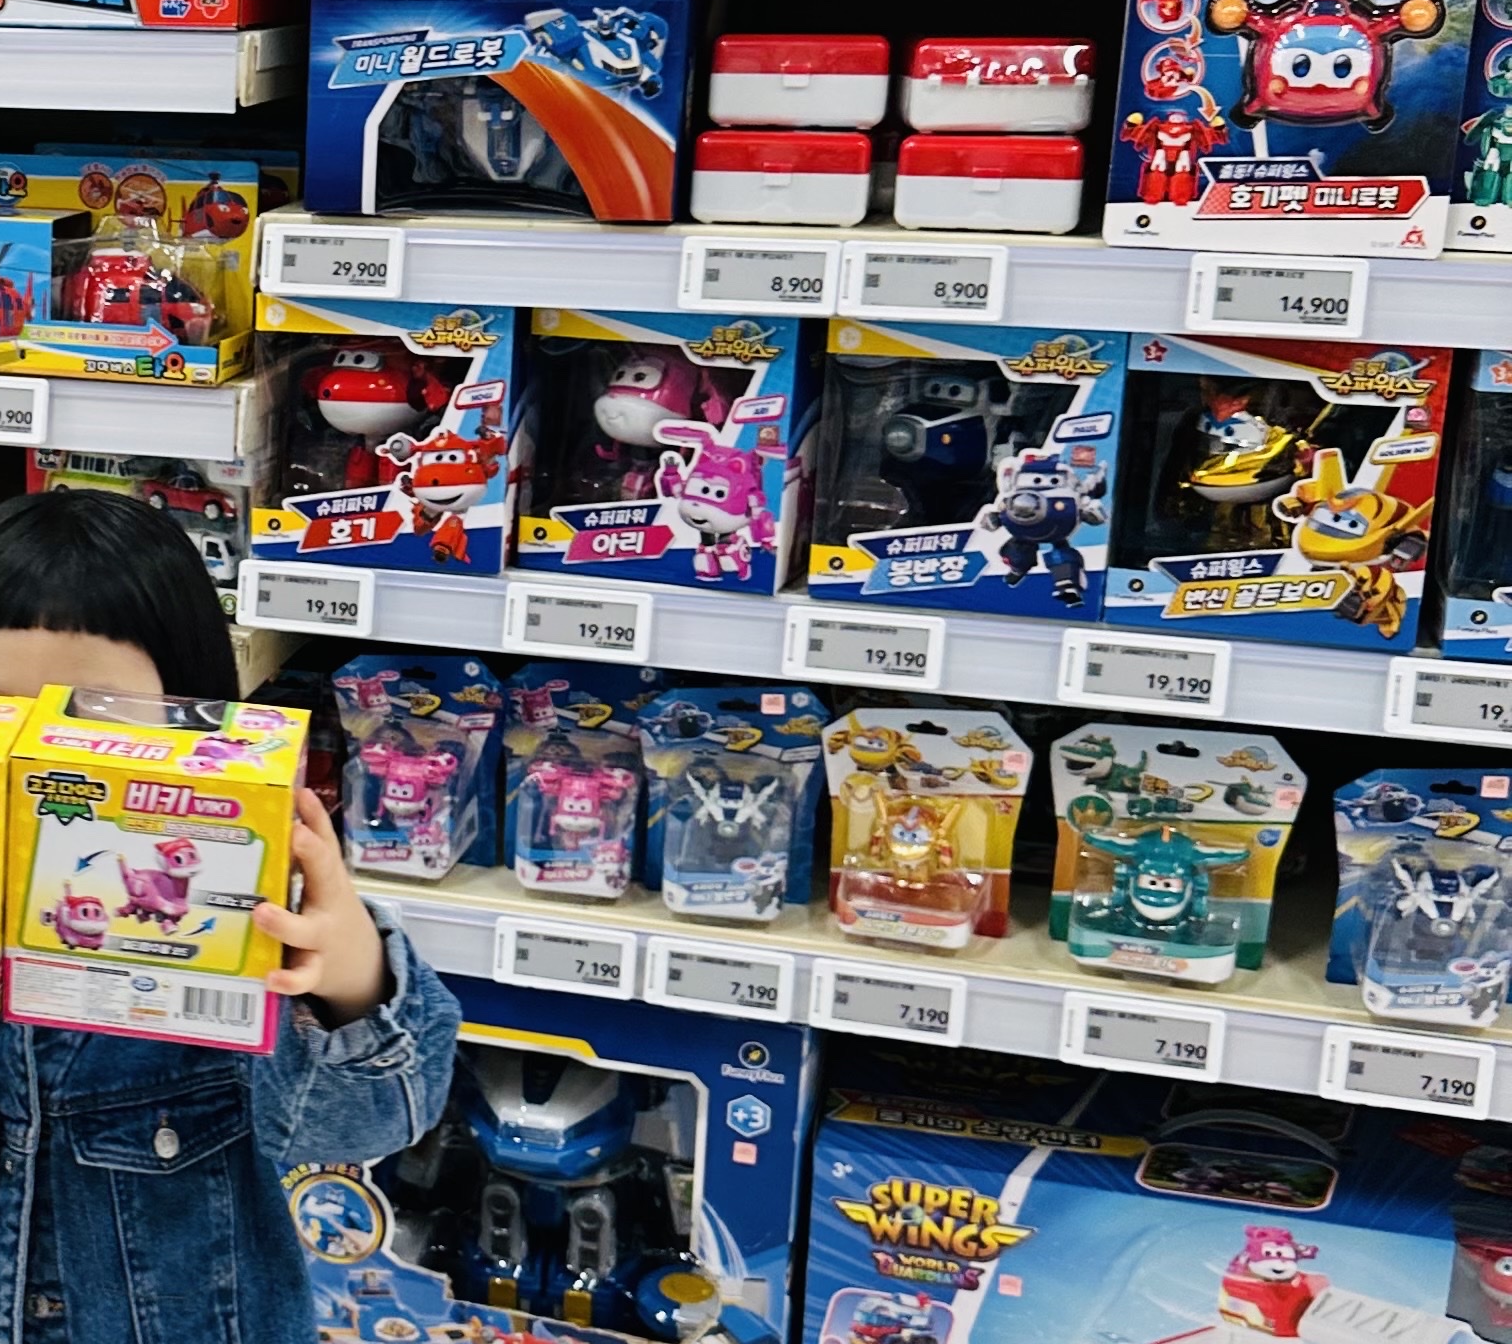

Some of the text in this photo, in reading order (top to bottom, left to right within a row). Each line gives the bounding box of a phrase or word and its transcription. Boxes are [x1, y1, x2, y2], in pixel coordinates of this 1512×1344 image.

[354, 51, 396, 76] 미니
[1218, 159, 1312, 181] 출동! 슈퍼윙스
[1229, 181, 1399, 212] 호기펫 미니로봇
[331, 261, 388, 281] 29,900
[769, 275, 824, 297] 8,900
[933, 280, 989, 301] 8,900
[1278, 294, 1350, 316] 14,900
[409, 328, 500, 350] 슈퍼윙스
[688, 339, 783, 362] 슈퍼윙스
[135, 351, 187, 381] 타요
[1004, 353, 1111, 380] 슈퍼윙스
[1319, 370, 1431, 399] 슈퍼윙스
[316, 494, 377, 517] 슈퍼파워
[584, 506, 647, 528] 슈퍼파워
[328, 515, 376, 543] 호기
[591, 528, 645, 555] 아리
[885, 532, 957, 556] 슈퍼파워
[886, 555, 969, 585] 봉반장
[1189, 555, 1264, 579] 슈퍼윙스
[1183, 578, 1337, 611] 변신 골든보이
[305, 598, 358, 618] 19,190
[578, 621, 635, 644] 19,190
[864, 648, 928, 670] 19,190
[1146, 672, 1212, 695] 19,190
[126, 779, 233, 817] 비키 VIKI
[574, 958, 621, 979] 7,190
[730, 981, 778, 1002] 7,190
[899, 1003, 949, 1025] 7,190
[1155, 1038, 1208, 1060] 7,190
[1419, 1074, 1476, 1099] 7,190
[870, 1178, 1002, 1226] SUPER
